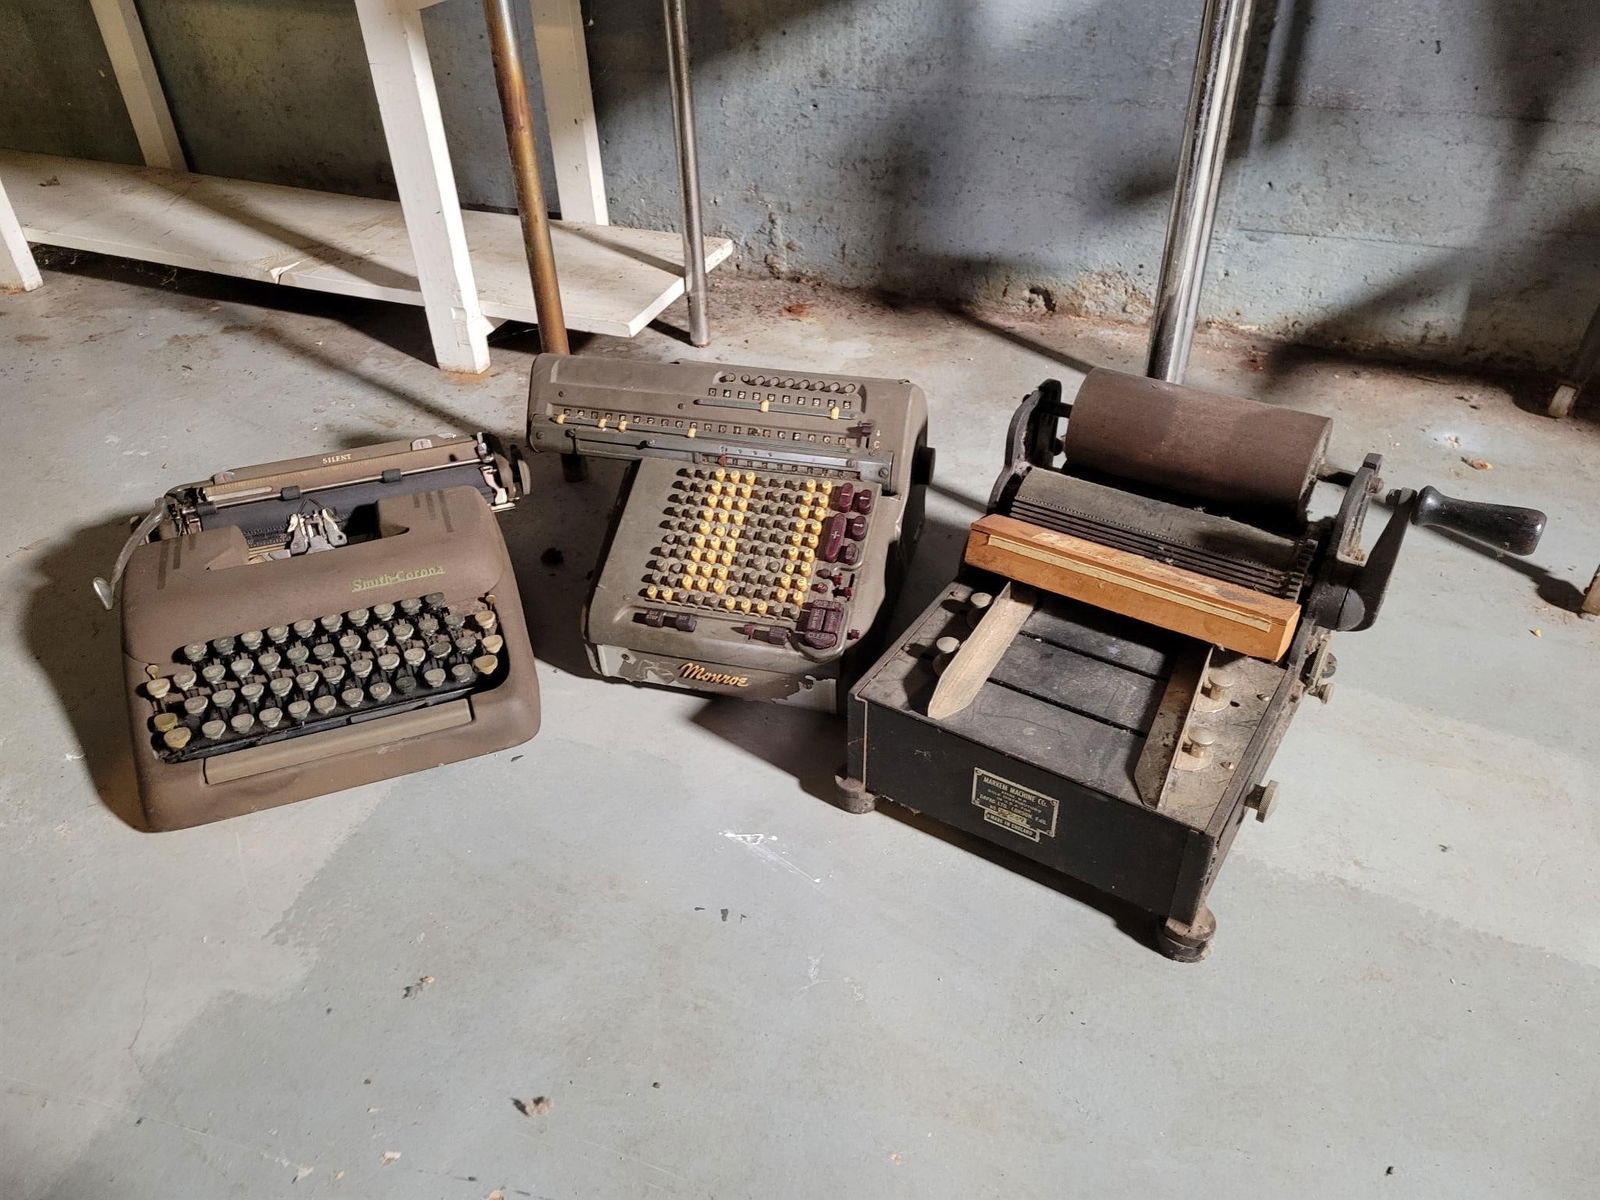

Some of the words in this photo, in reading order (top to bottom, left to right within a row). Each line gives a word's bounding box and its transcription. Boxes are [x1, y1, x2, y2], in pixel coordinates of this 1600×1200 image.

[322, 453, 352, 464] SILENT
[351, 566, 446, 592] Smith-Corona
[678, 662, 749, 687] Monroe
[1009, 786, 1035, 802] MACHINE
[990, 815, 1003, 823] MADE
[1011, 824, 1033, 836] ENGLAND
